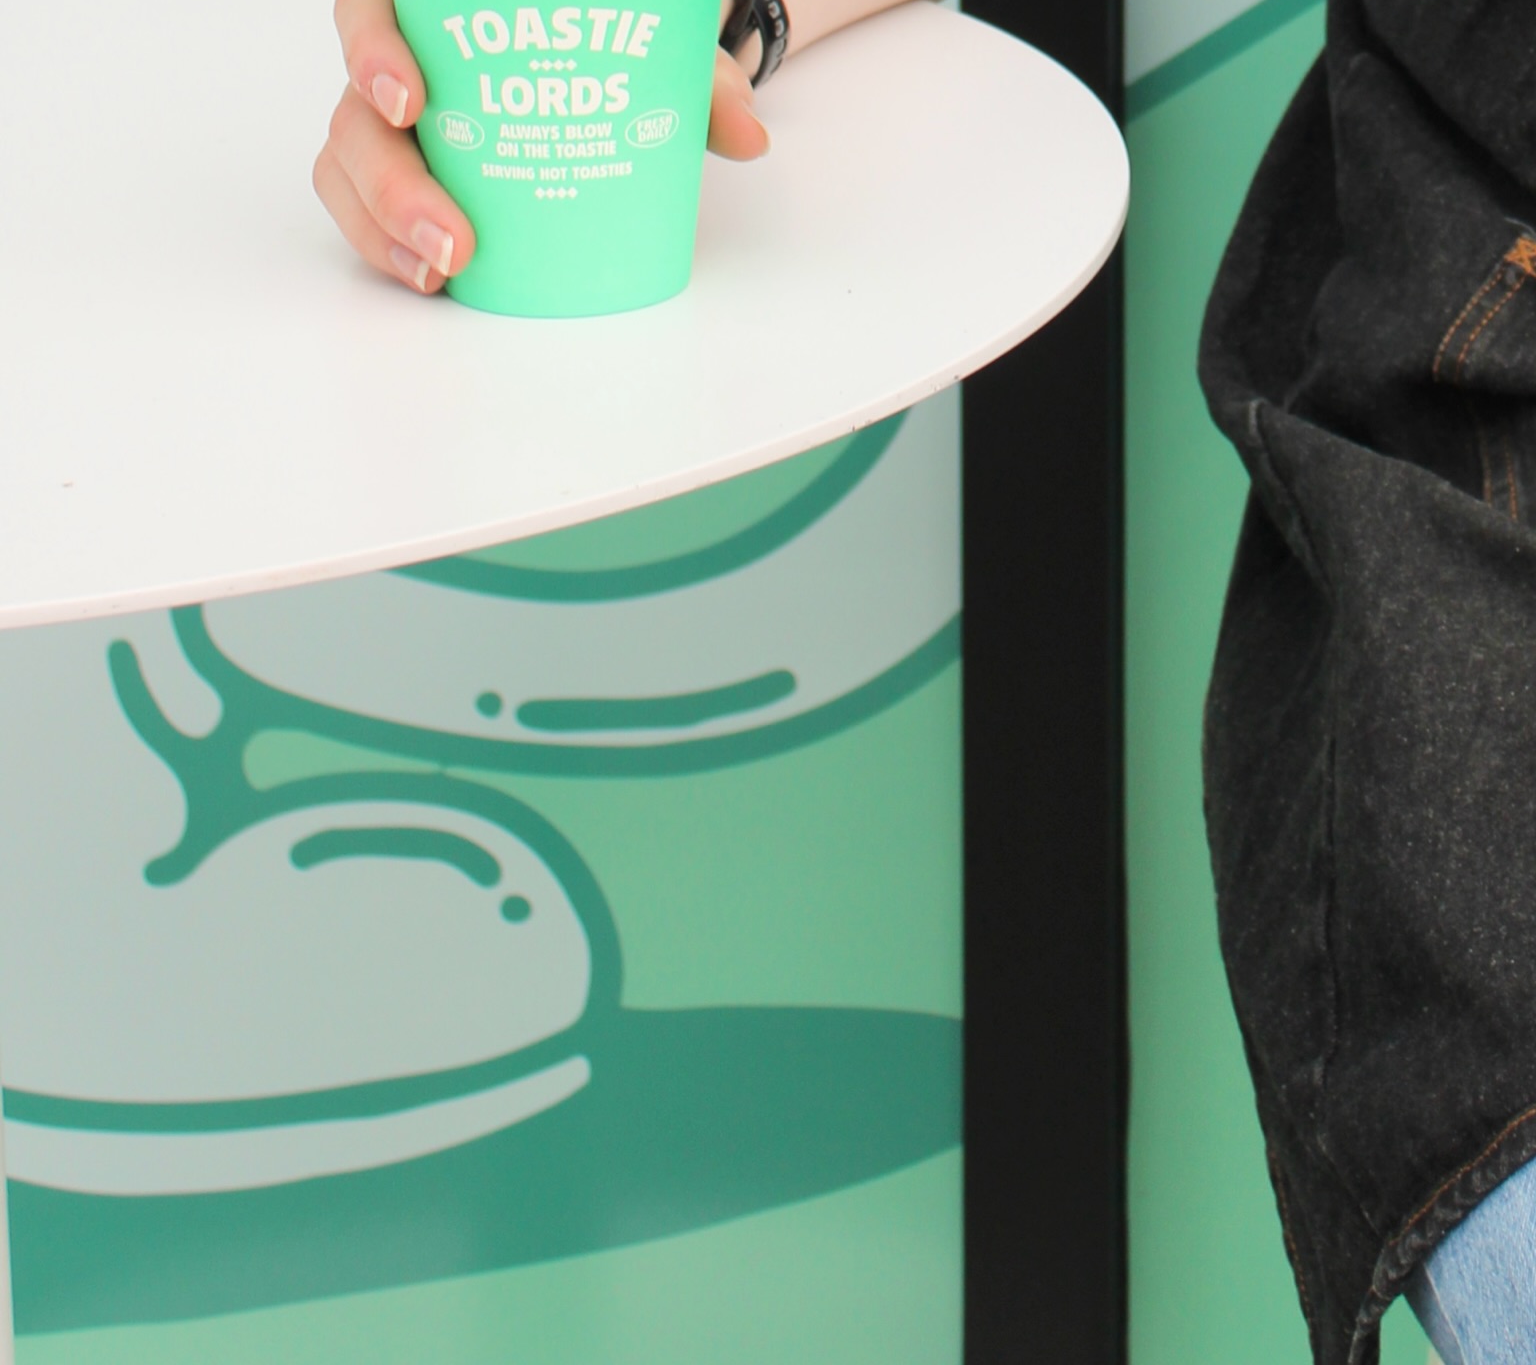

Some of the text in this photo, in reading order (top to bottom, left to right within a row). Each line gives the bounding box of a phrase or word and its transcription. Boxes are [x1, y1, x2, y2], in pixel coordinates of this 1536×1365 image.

[443, 6, 662, 61] TOASTIE
[479, 72, 630, 117] LORDS
[499, 122, 613, 140] ALWAYS BLOW
[496, 140, 617, 159] ON THE TOASTIE
[481, 160, 633, 181] SERVING HOT TOASTIES
